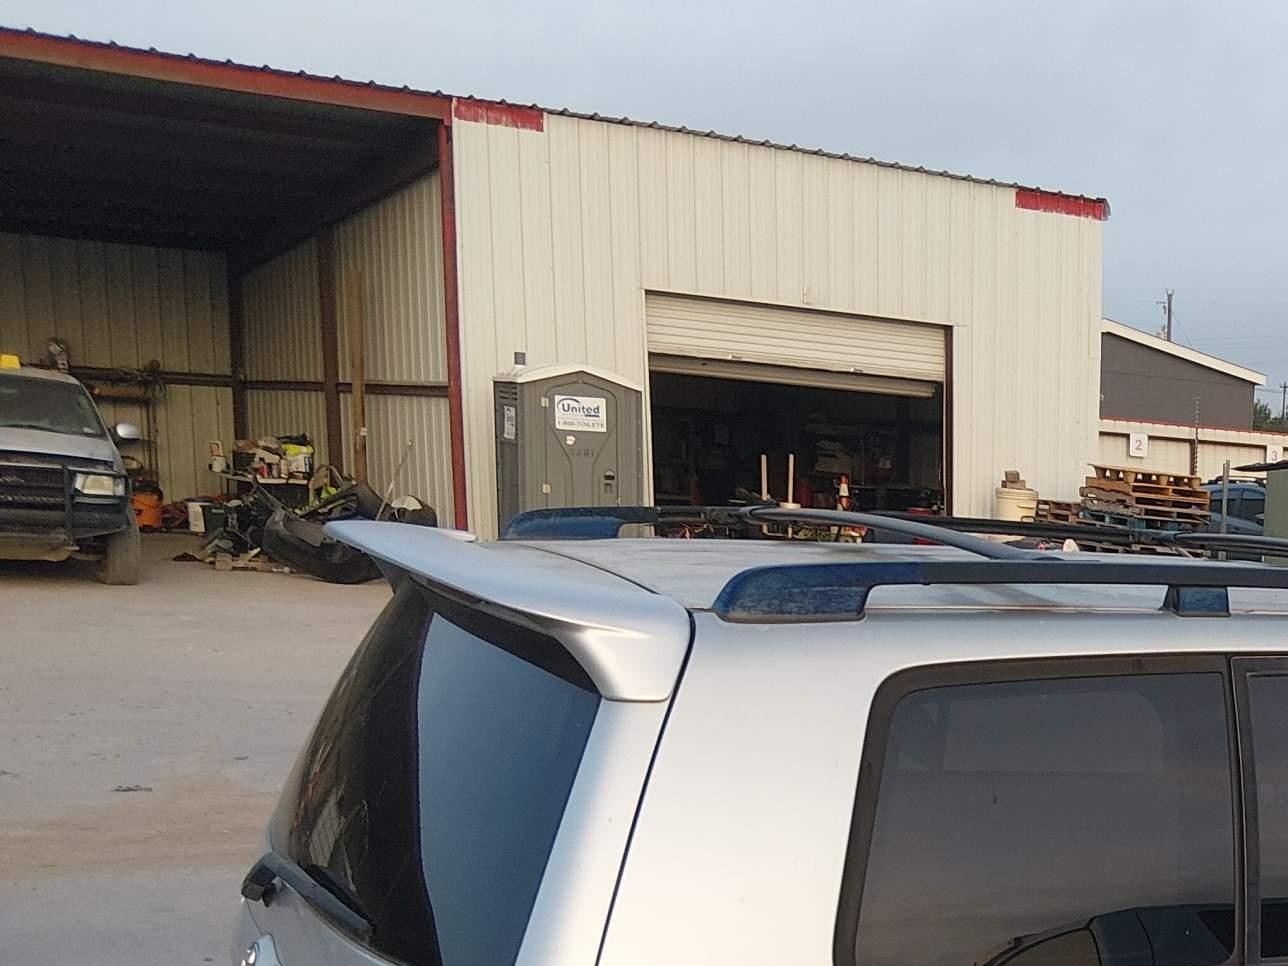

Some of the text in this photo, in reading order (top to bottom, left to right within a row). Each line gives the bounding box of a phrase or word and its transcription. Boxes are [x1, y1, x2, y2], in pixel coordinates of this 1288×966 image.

[562, 403, 600, 414] United
[1135, 439, 1143, 450] 2
[1271, 450, 1278, 461] 3
